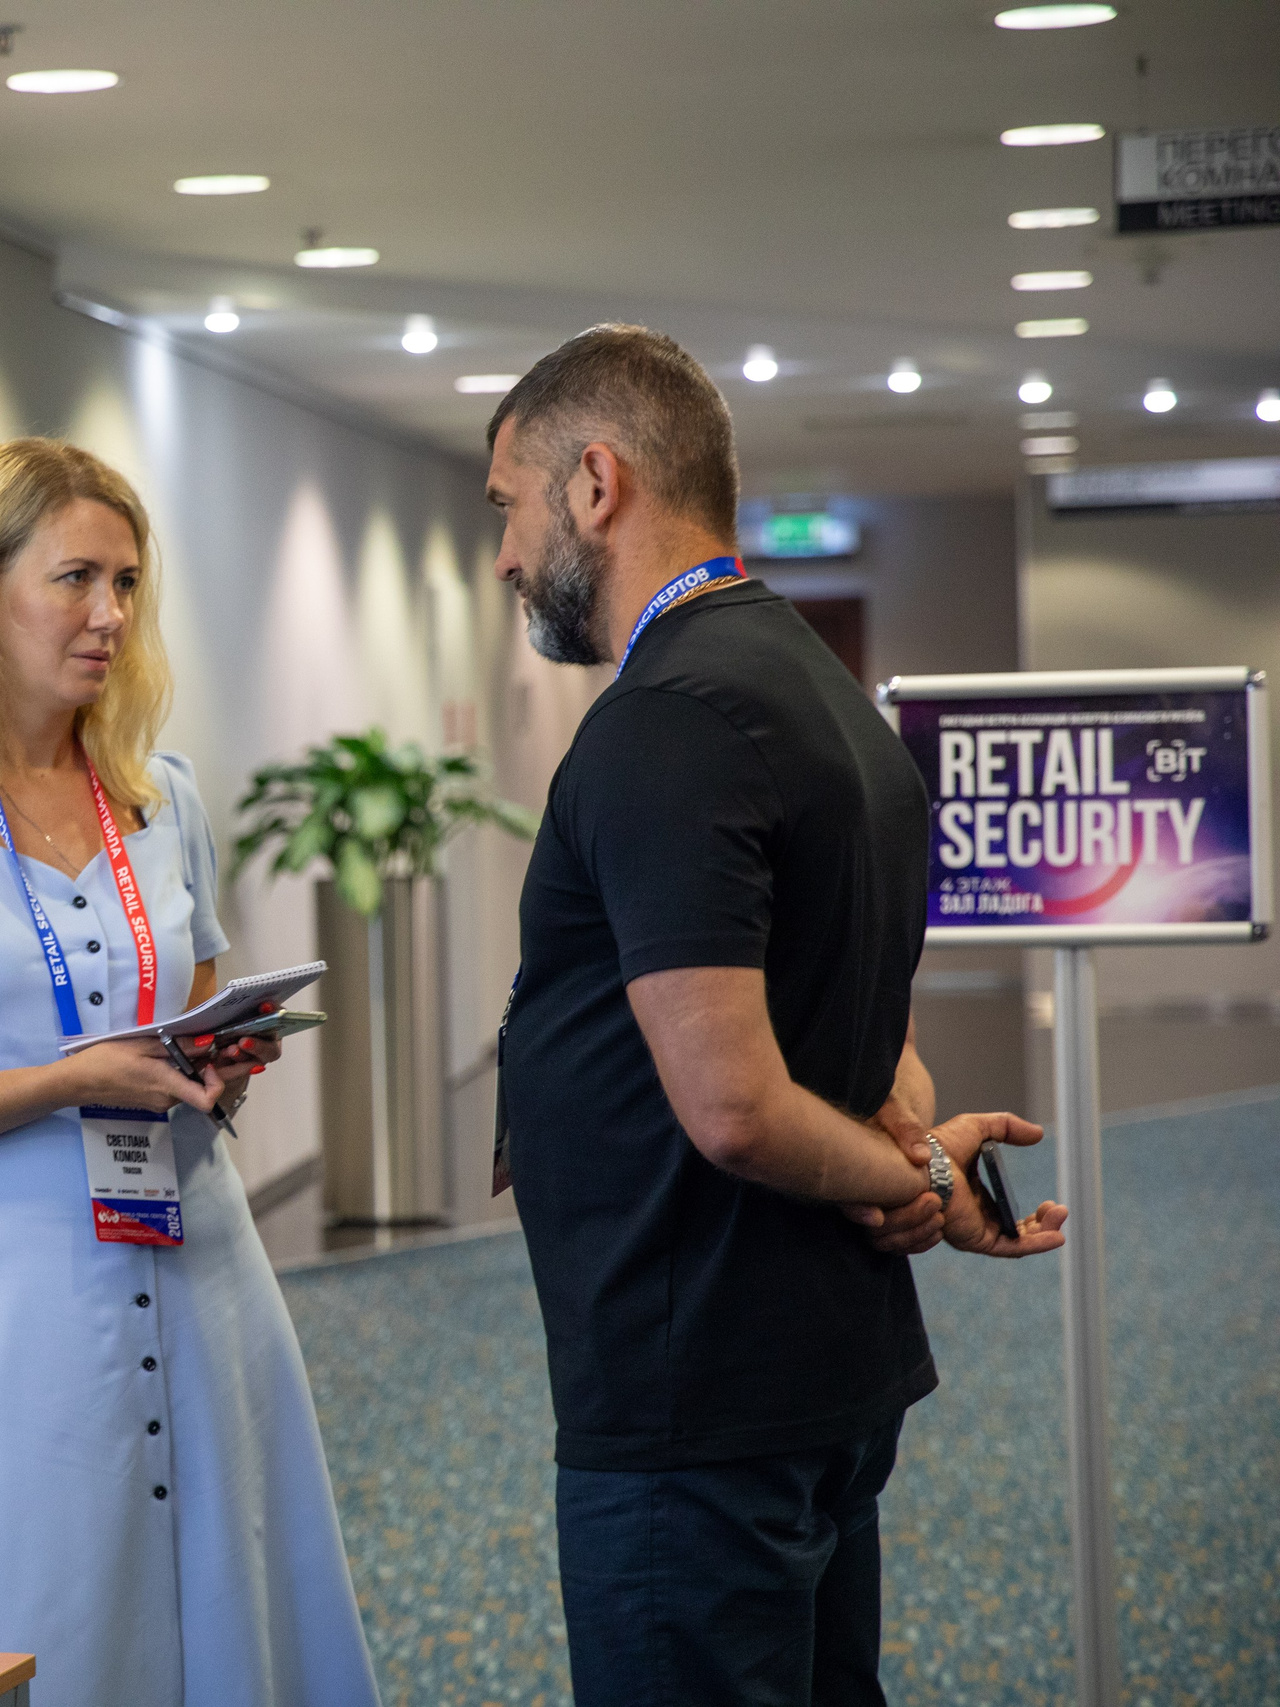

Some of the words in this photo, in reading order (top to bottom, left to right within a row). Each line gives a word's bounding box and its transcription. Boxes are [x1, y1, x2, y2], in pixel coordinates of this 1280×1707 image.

[940, 728, 1130, 798] RETAIL
[95, 790, 122, 859] РИТЕЙЛА
[939, 797, 1206, 868] SECURITY
[116, 866, 138, 914] RETAIL
[131, 916, 154, 991] SECURITY
[940, 893, 975, 914] ЗАЛ
[43, 932, 68, 987] RETAIL
[106, 1134, 151, 1148] СВЕТЛАНА
[113, 1150, 148, 1163] КОМОВА
[166, 1206, 181, 1237] 2024
